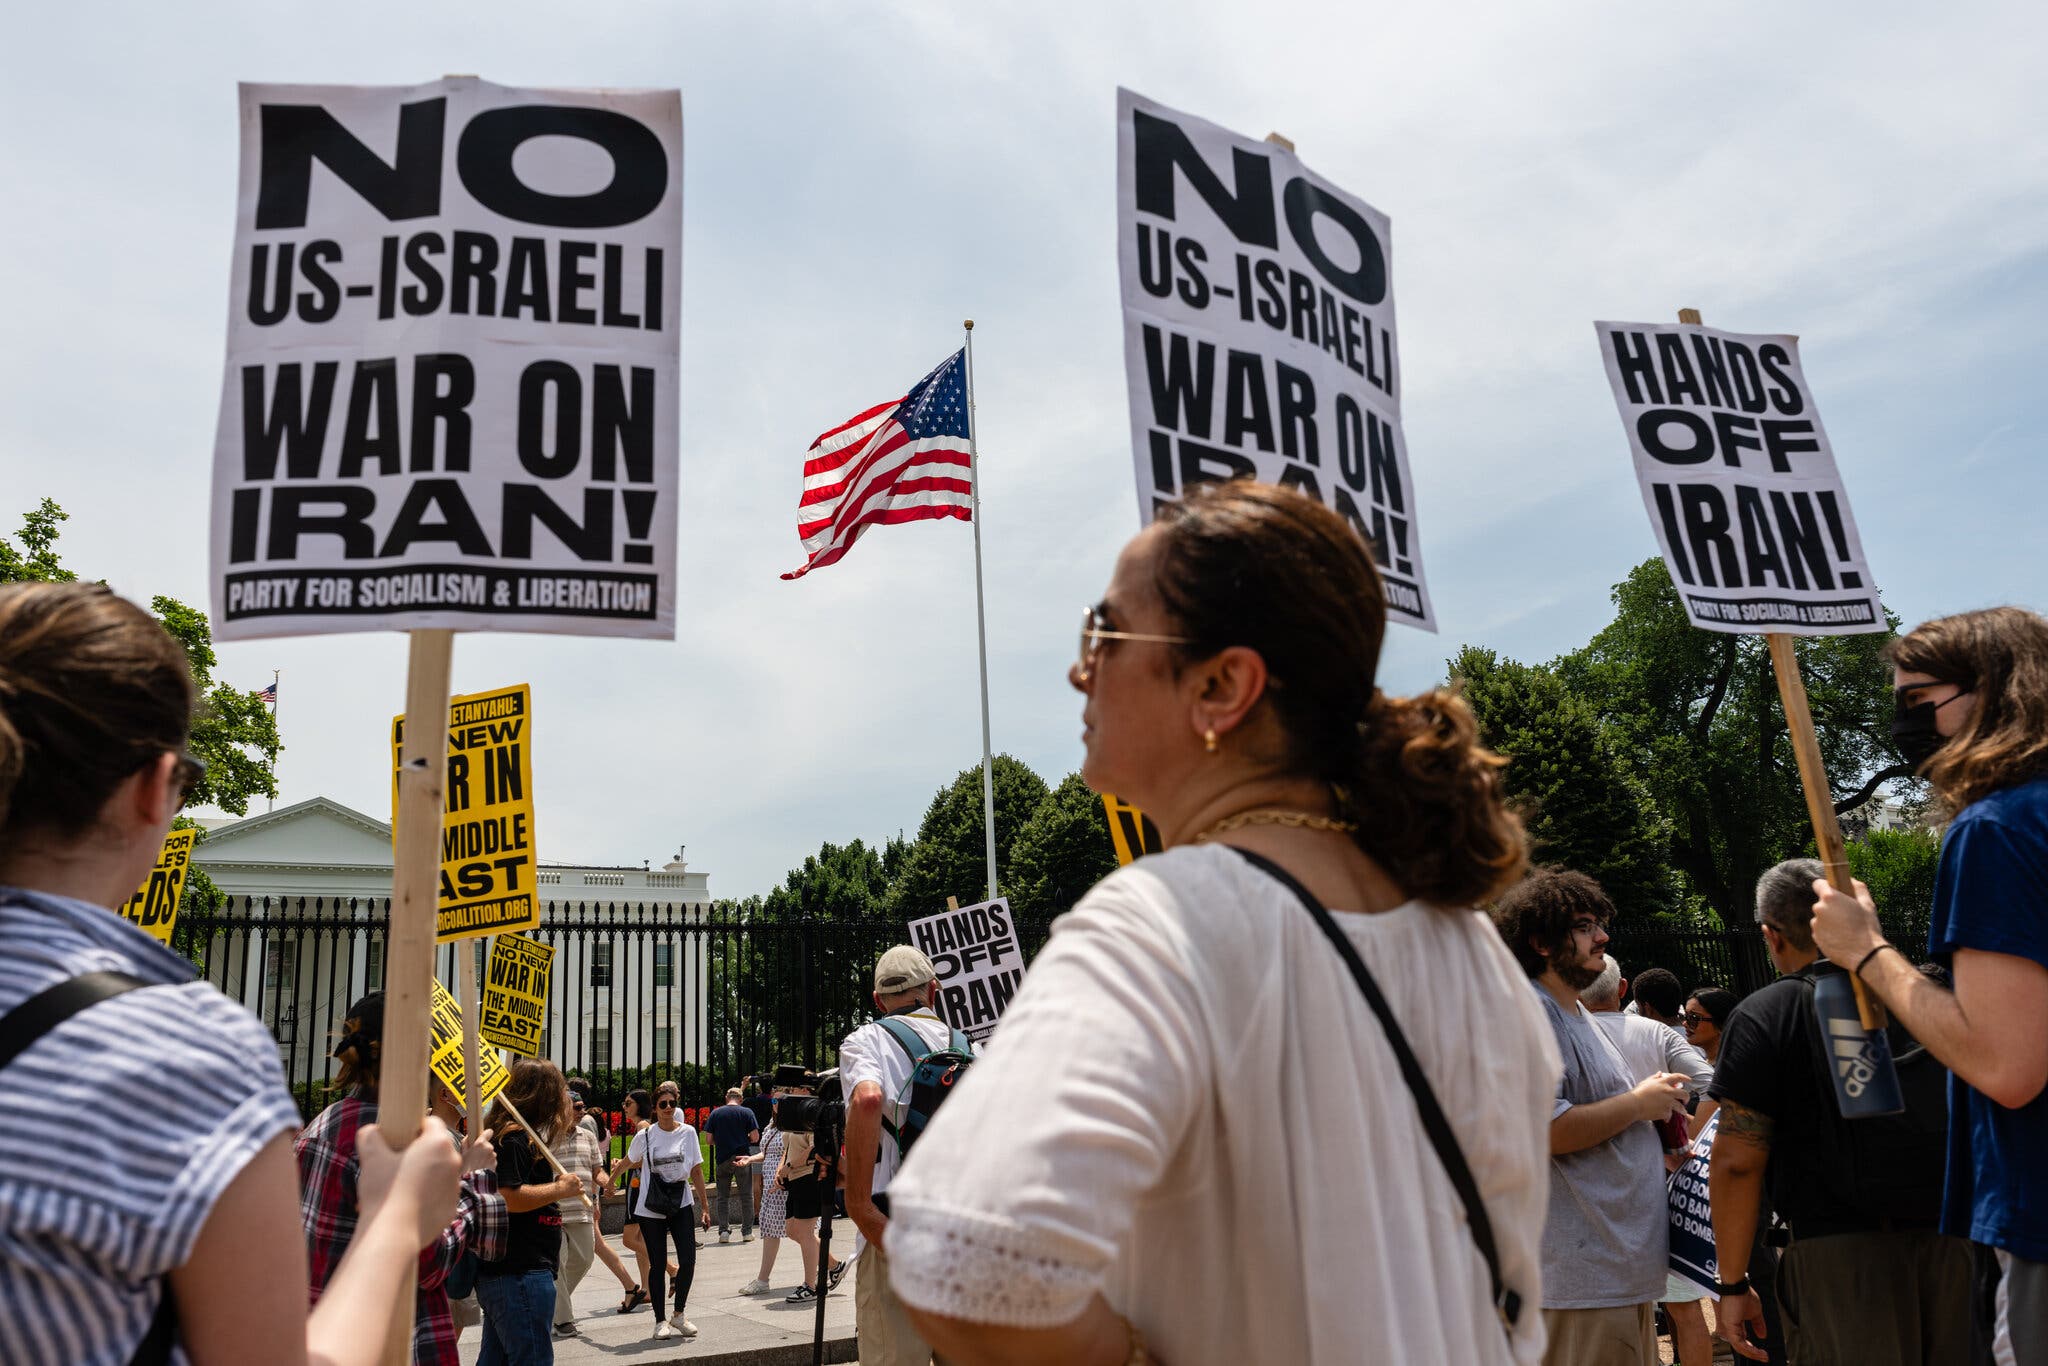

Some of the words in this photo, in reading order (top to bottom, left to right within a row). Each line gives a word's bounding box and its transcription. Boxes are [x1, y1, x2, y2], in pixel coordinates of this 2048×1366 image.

[255, 96, 669, 230] NO
[1133, 108, 1387, 307] NO
[248, 229, 664, 331] US-ISRAELI
[1136, 222, 1393, 398] US-ISRAELI
[1610, 331, 1804, 416] HANDS
[242, 353, 476, 482] WAR
[517, 359, 655, 483] ON
[1142, 322, 1320, 468] WAR
[1337, 392, 1405, 513] ON
[1637, 408, 1820, 473] OFF
[230, 478, 657, 565] IRAN!
[1652, 483, 1863, 591] IRAN!
[229, 578, 298, 612] PARTY
[305, 578, 352, 608] FOR
[358, 573, 486, 606] SOCIALISM
[493, 580, 511, 607] &
[518, 577, 651, 612] LIBERATION
[1690, 599, 1721, 619] PARTY
[1719, 603, 1742, 620] FOR
[1740, 603, 1800, 621] SOCIALISM
[1807, 604, 1872, 622] LIBERATION
[449, 697, 518, 727] ETANYAHU:
[484, 743, 523, 806] IN
[165, 836, 190, 851] FOR
[441, 813, 527, 863] MIDDLE
[915, 904, 1009, 956] HANDS
[490, 957, 530, 993] WAR
[532, 970, 545, 999] IN
[494, 945, 516, 960] NO
[520, 953, 548, 972] NEW
[932, 937, 1014, 980] OFF
[484, 1010, 540, 1039] EAST
[487, 990, 505, 1010] THE
[508, 996, 543, 1022] MIDDLE
[434, 1051, 463, 1078] THE
[1670, 1190, 1687, 1209] NO
[1688, 1198, 1711, 1221] BAN
[1676, 1174, 1691, 1190] NO
